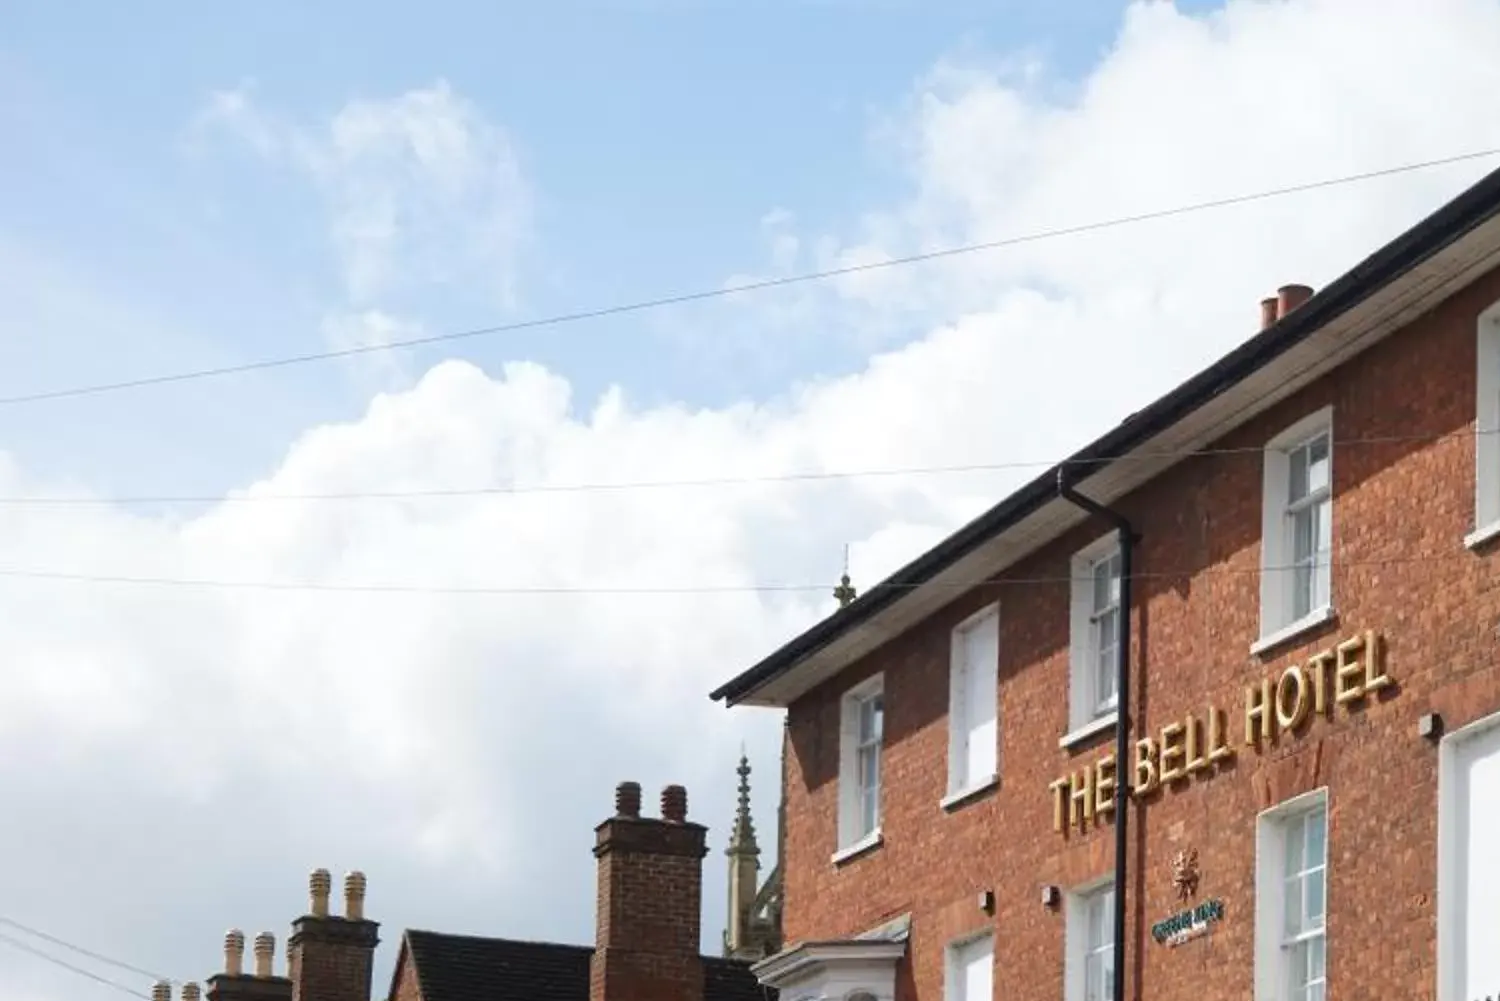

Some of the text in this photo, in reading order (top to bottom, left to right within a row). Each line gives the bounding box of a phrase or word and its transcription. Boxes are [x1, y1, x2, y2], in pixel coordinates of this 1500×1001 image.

[1048, 630, 1391, 834] THE BELL HOTEL
